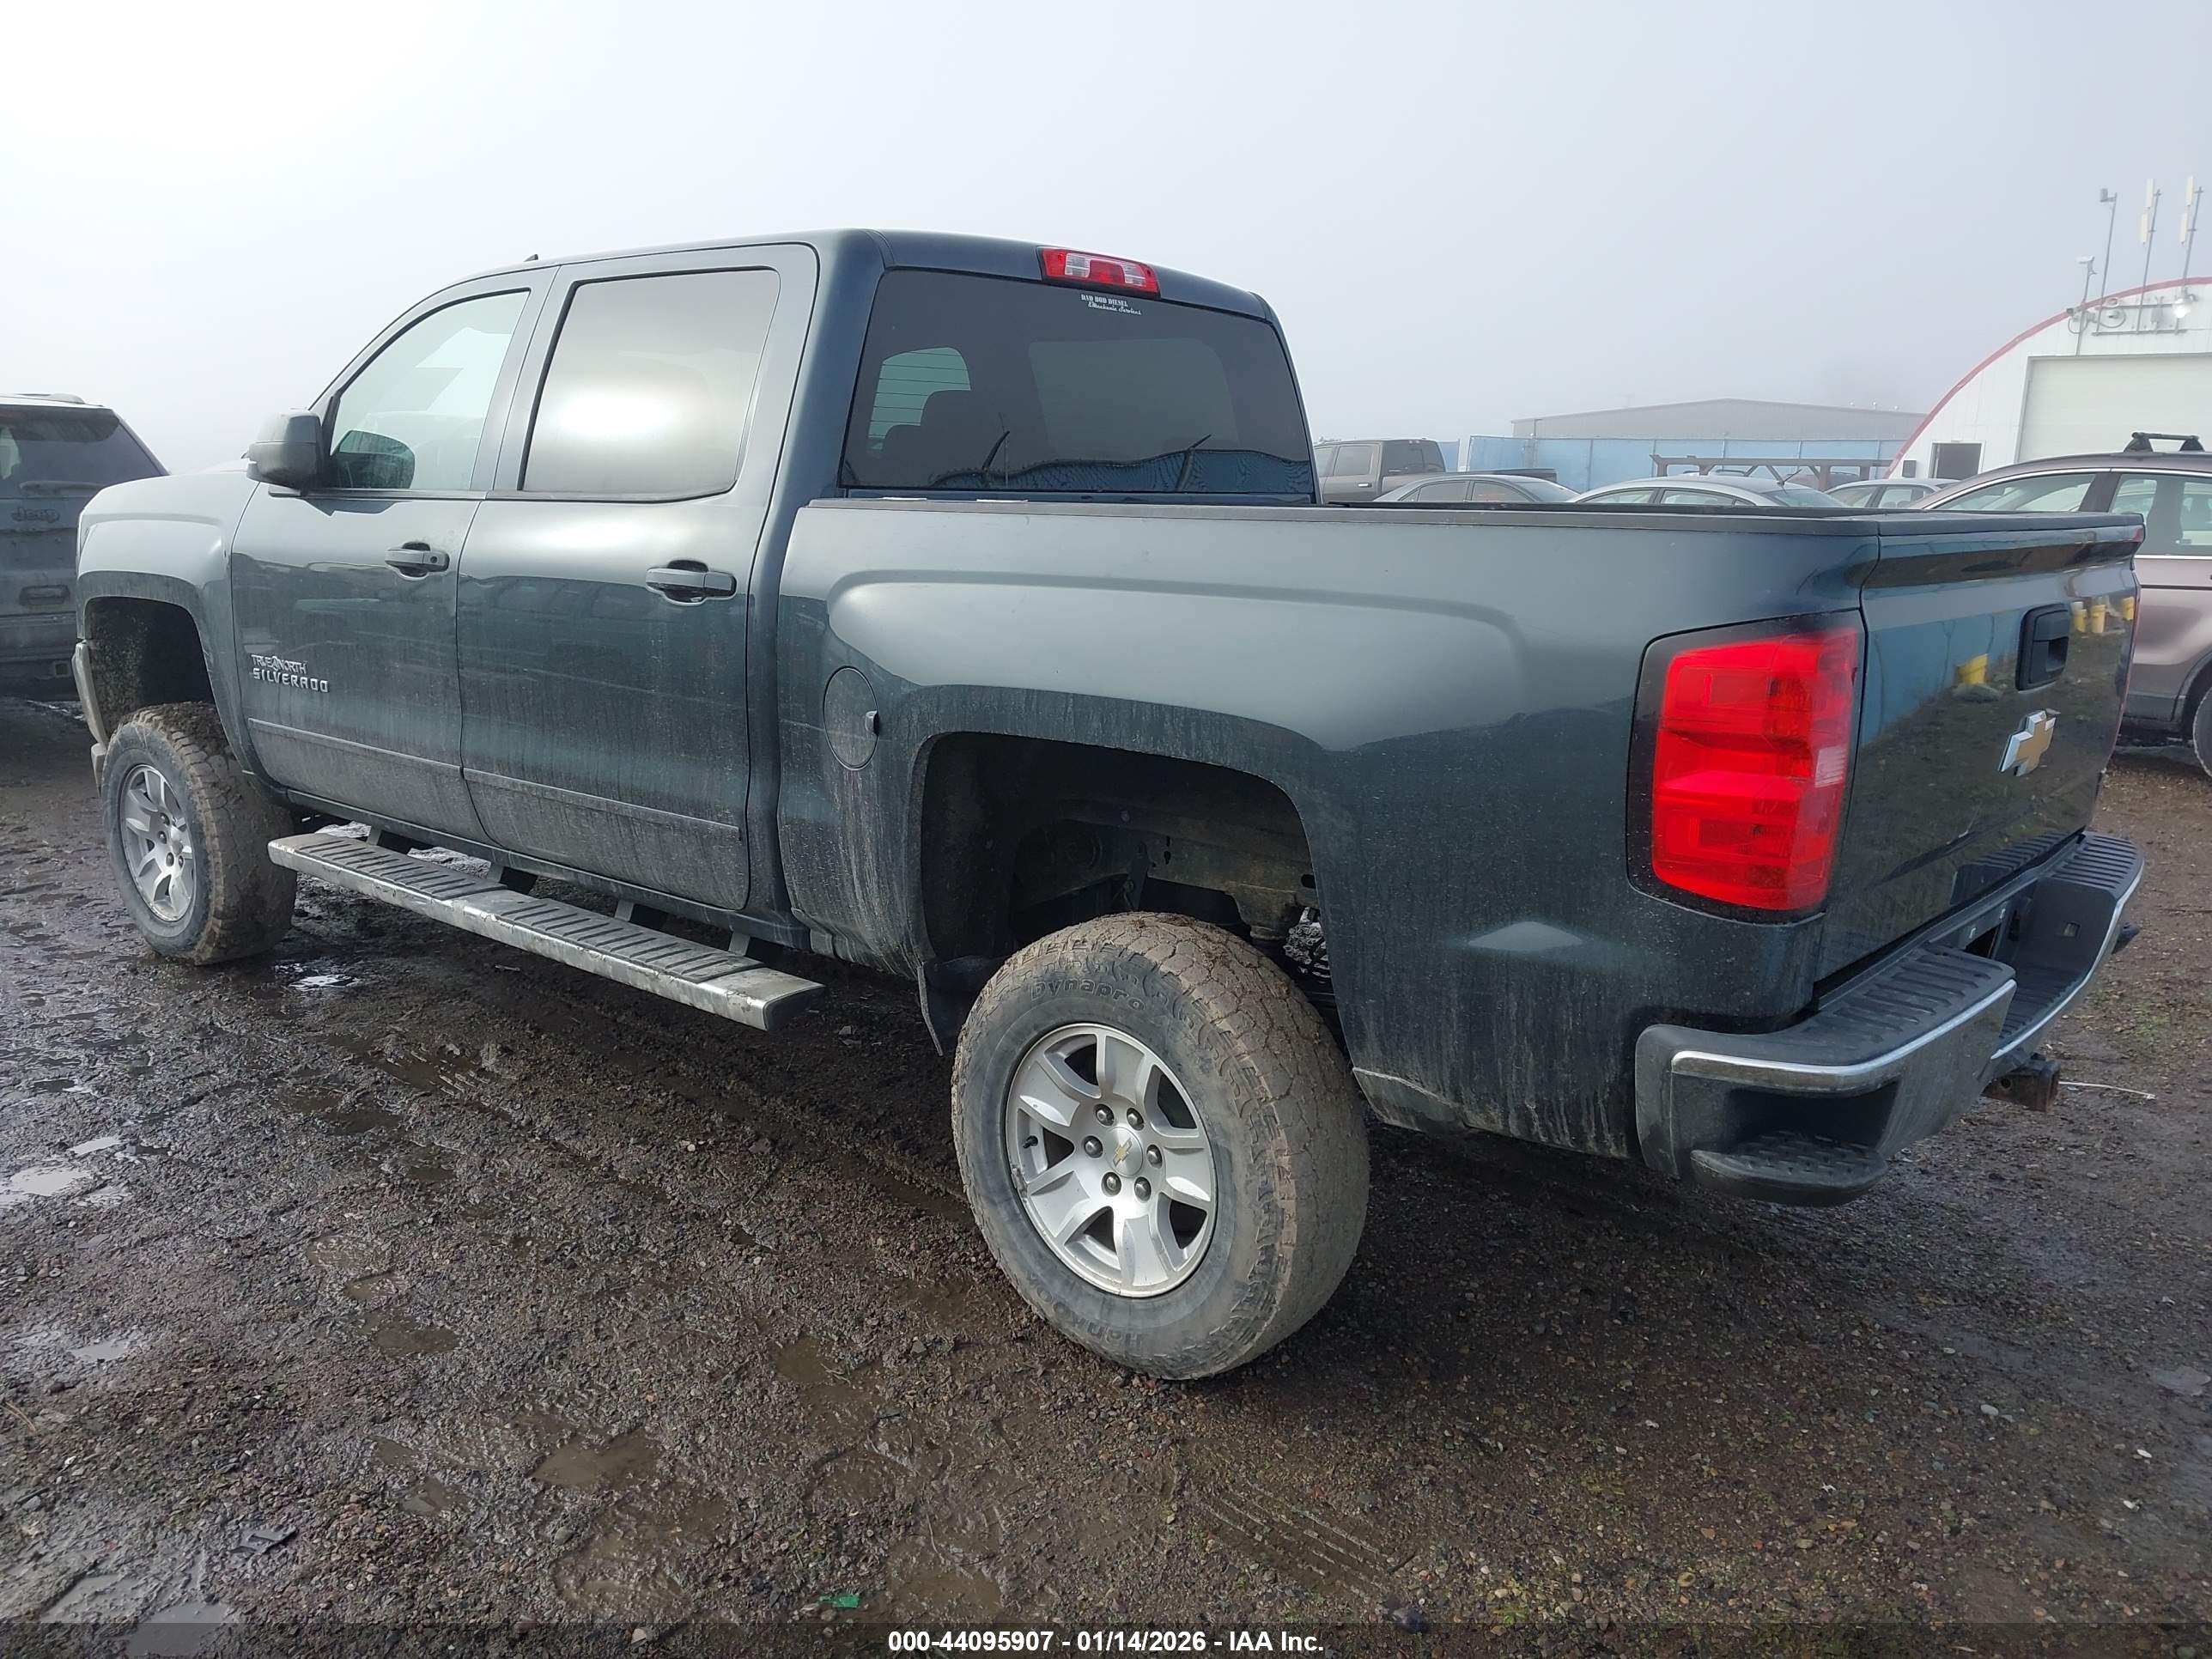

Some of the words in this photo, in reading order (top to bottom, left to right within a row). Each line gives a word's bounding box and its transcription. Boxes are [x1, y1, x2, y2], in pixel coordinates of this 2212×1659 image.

[10, 507, 60, 523] Jeep
[276, 659, 307, 674] NORTH
[252, 667, 329, 693] SILVERADO
[1030, 977, 1146, 1011] Dynapro
